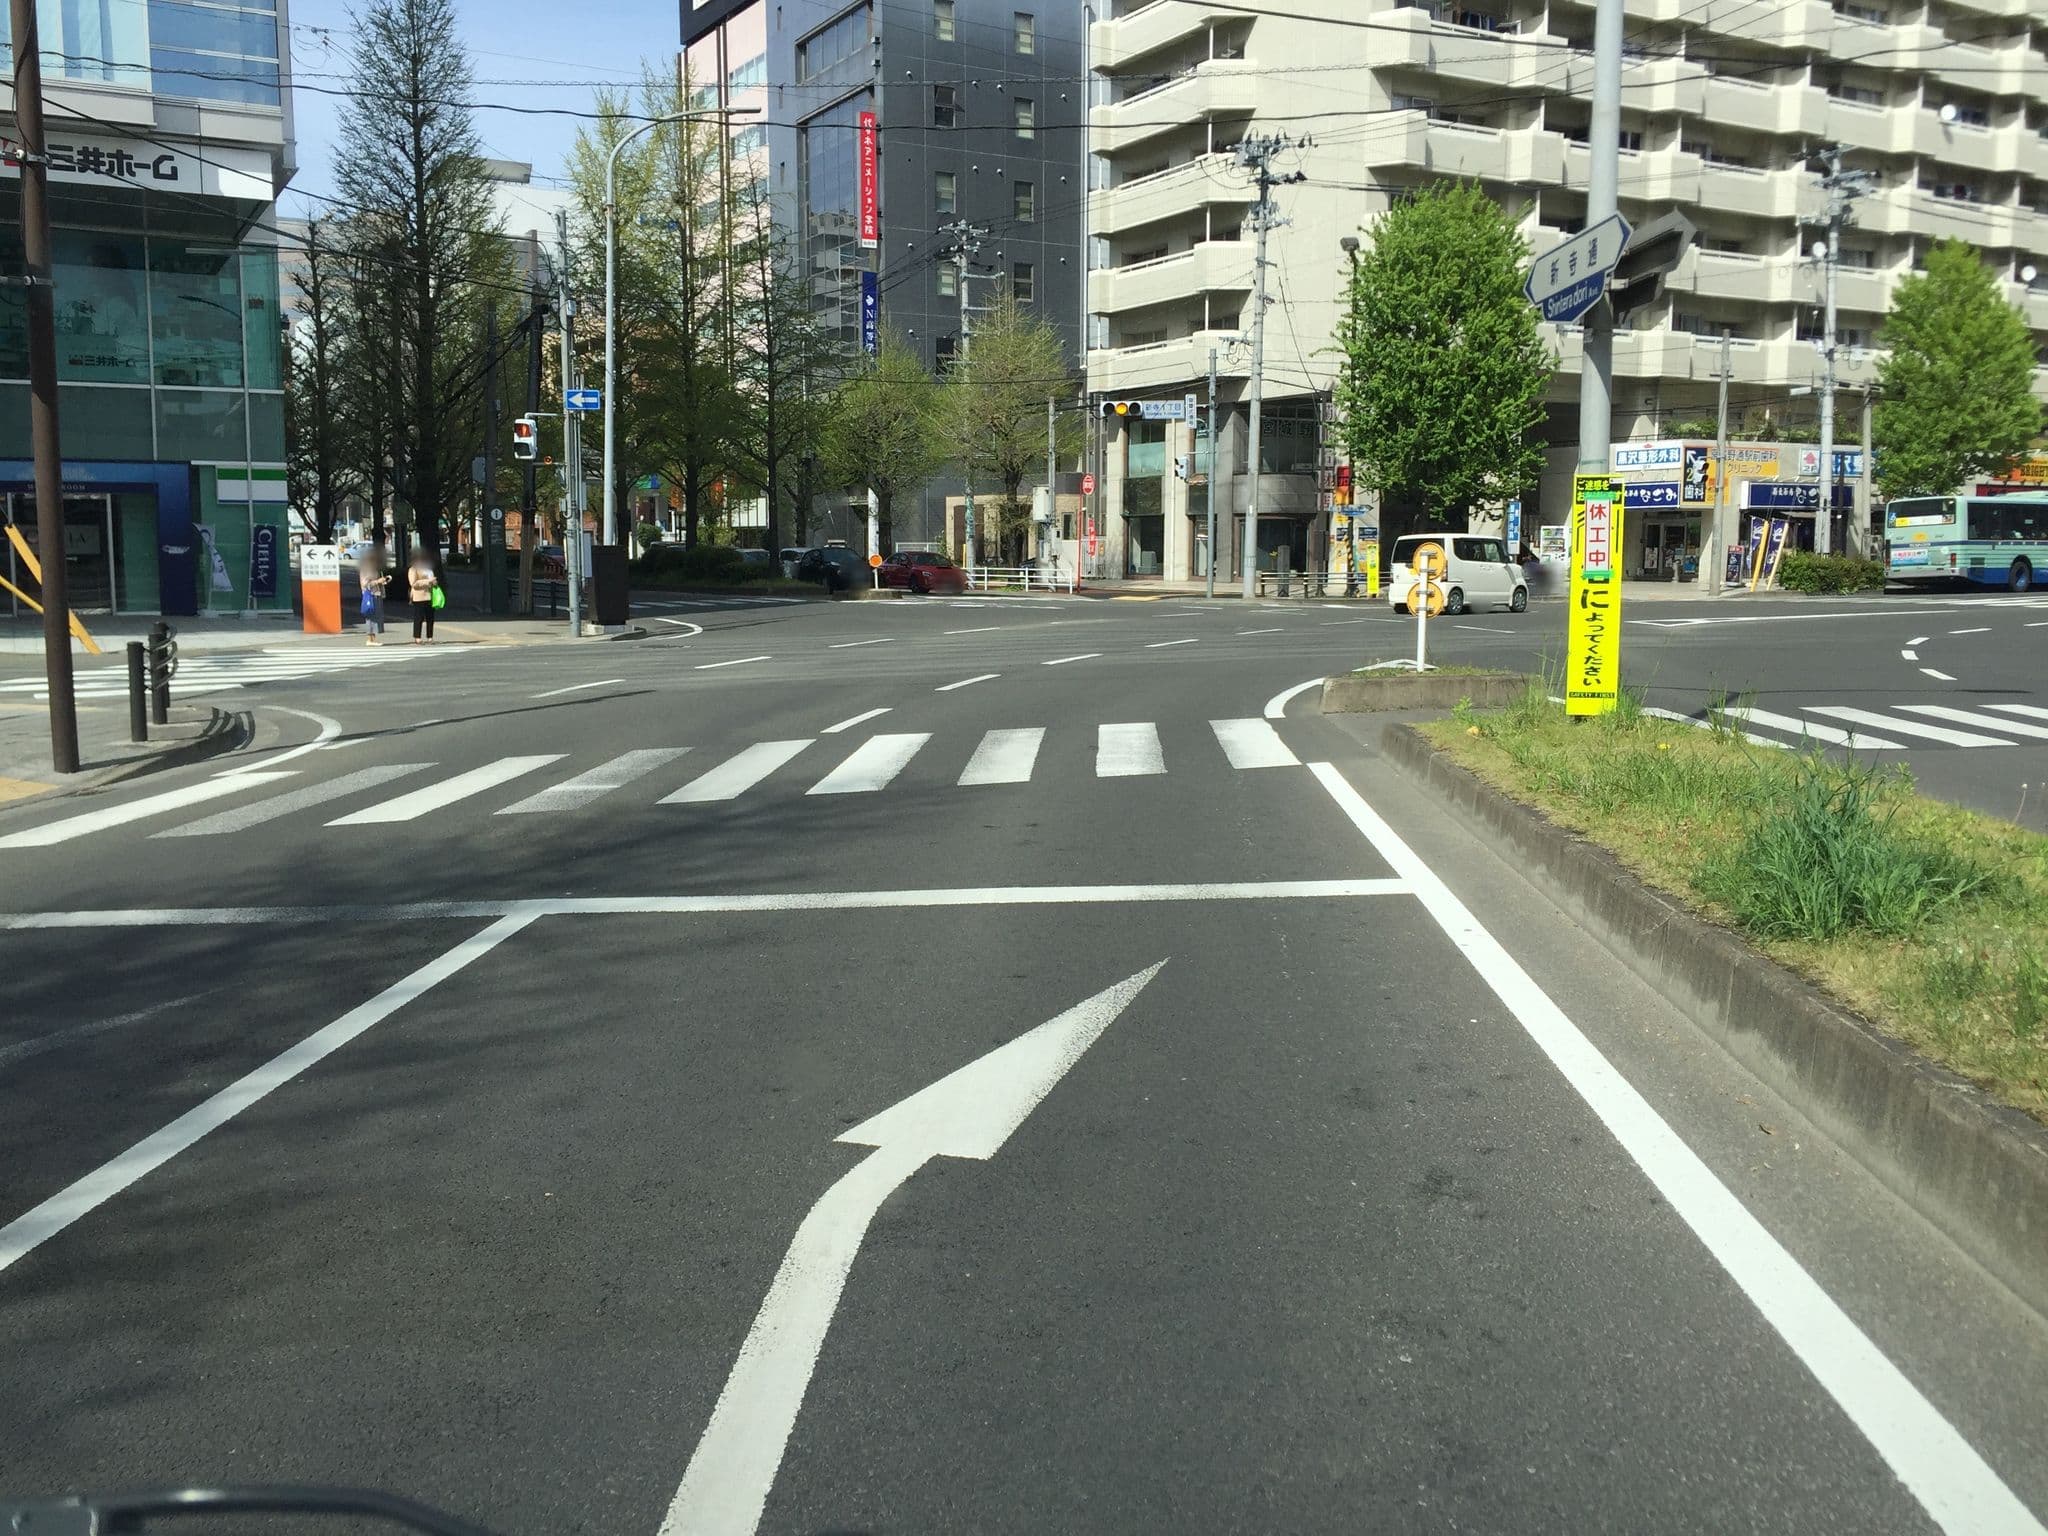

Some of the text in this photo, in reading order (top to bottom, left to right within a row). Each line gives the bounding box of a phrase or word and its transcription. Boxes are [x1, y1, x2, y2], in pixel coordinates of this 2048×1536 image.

[48, 144, 178, 181] 三井ホーム
[865, 309, 875, 357] N高等学
[1617, 448, 1679, 465] 黒沢整形外科
[1711, 448, 1777, 463] 宮野通駅前歯科
[1727, 462, 1762, 474] クリニック
[1685, 484, 1704, 500] 歯科
[1589, 503, 1607, 567] 休工中
[1581, 588, 1610, 686] によってください
